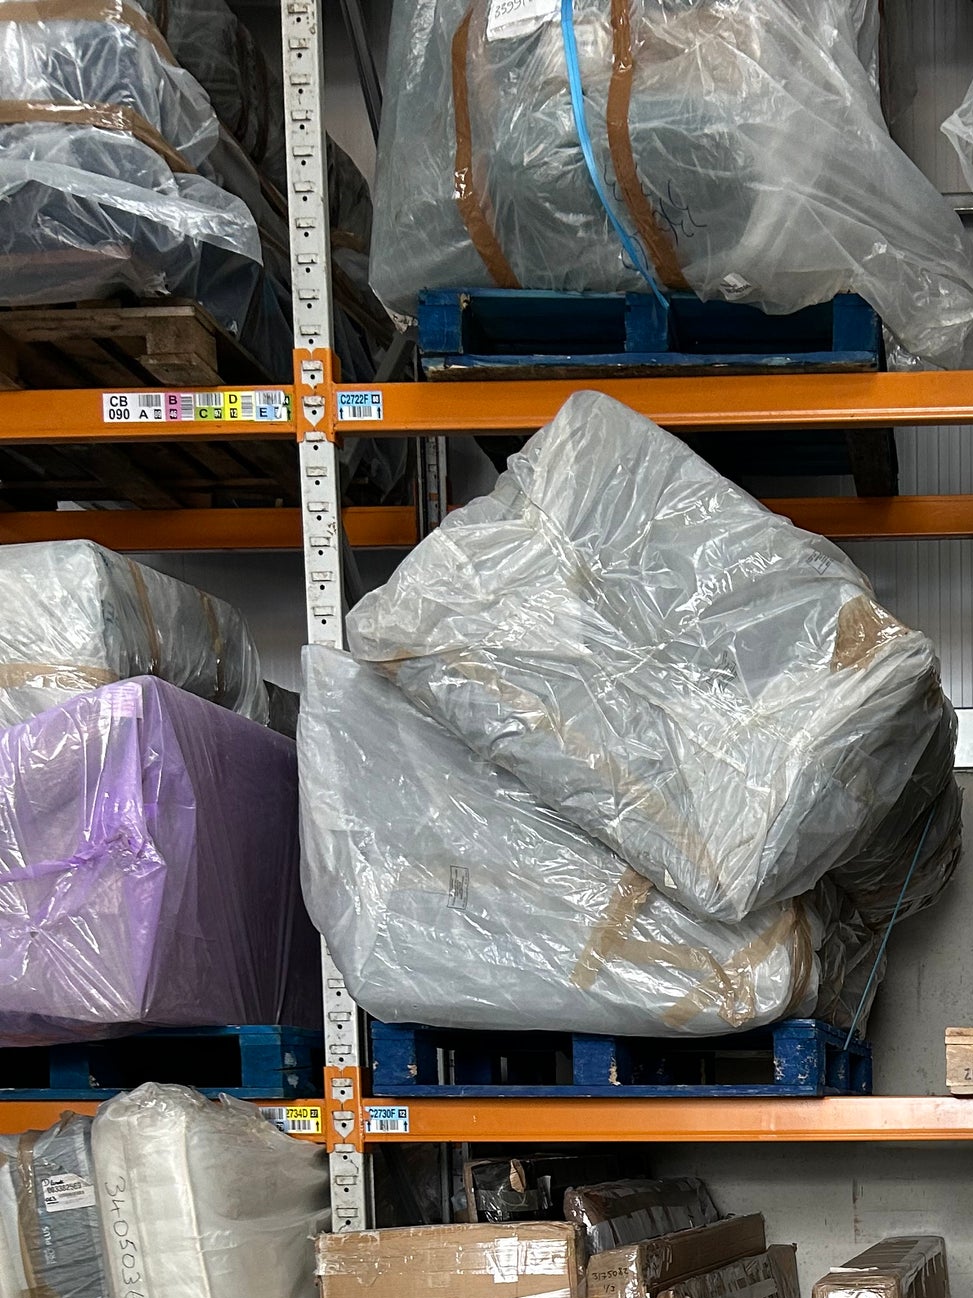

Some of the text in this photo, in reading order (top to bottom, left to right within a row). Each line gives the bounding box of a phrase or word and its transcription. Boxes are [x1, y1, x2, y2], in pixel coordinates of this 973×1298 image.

[110, 396, 128, 407] CB
[169, 395, 177, 405] B
[229, 394, 237, 404] D
[340, 394, 369, 404] C2722F
[109, 409, 130, 420] 090
[139, 409, 149, 419] A
[199, 409, 208, 418] C
[260, 408, 267, 417] E
[286, 1108, 307, 1118] 2734D
[369, 1108, 395, 1118] C2730F
[42, 1226, 52, 1245] PLUS
